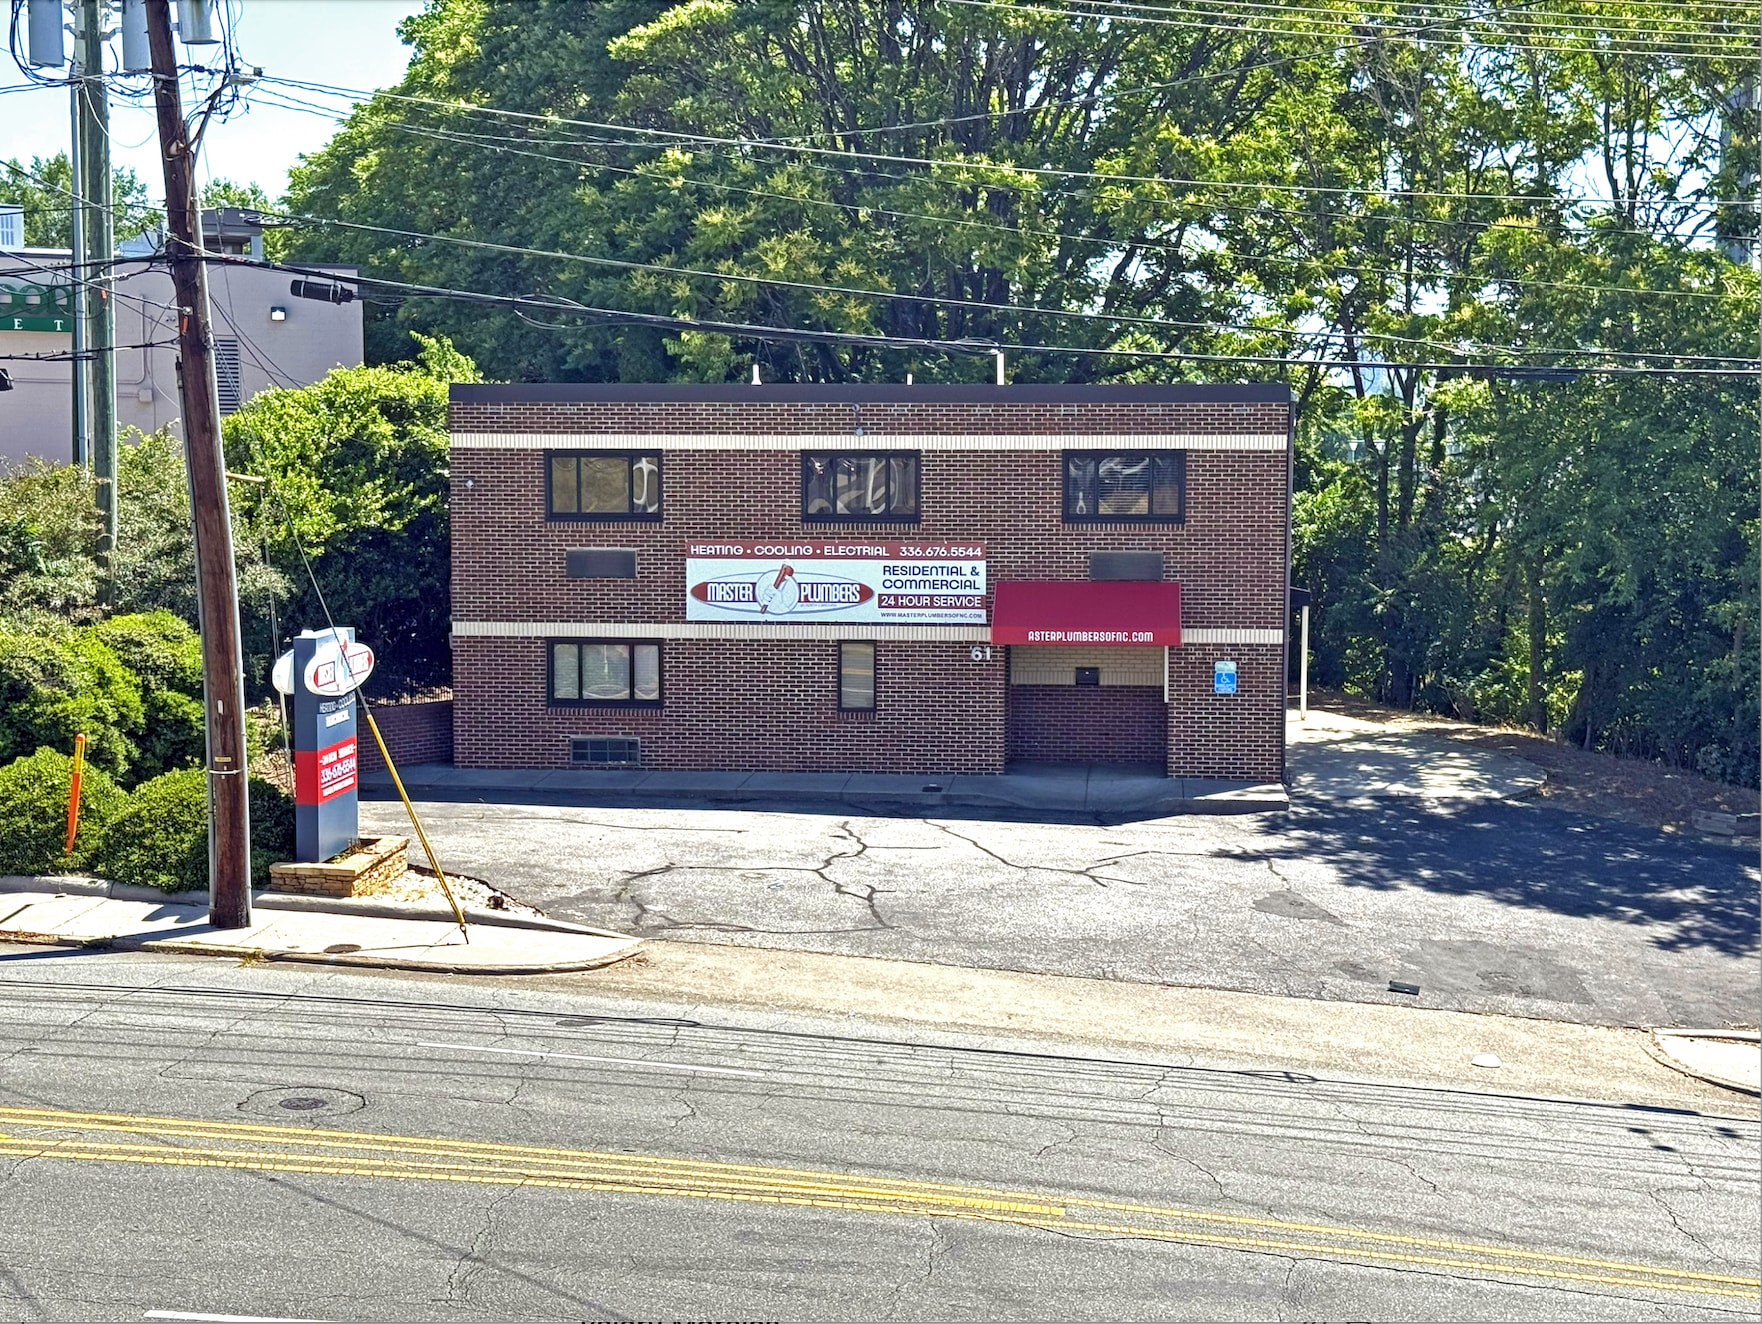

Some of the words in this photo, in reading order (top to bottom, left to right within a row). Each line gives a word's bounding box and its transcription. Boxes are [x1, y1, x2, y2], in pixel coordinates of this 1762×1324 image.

[690, 545, 743, 556] HEATING
[754, 545, 813, 556] COOLING
[824, 545, 890, 557] ELECTRIAL
[899, 546, 982, 557] 336.676.5544
[882, 565, 967, 577] RESIDENTIAL
[970, 566, 980, 577] &
[882, 578, 981, 590] COMMERCIAL
[707, 583, 753, 601] MASTER
[800, 583, 861, 603] PLUMBERS
[881, 596, 896, 607] 24
[898, 596, 931, 607] HOUR
[933, 596, 981, 608] SERVICE
[880, 611, 983, 619] WWW.MASTERPLUMBERSOFNC.COM
[1028, 630, 1154, 643] ASTERPLUMBERSOFNC.COM
[970, 646, 992, 661] 61
